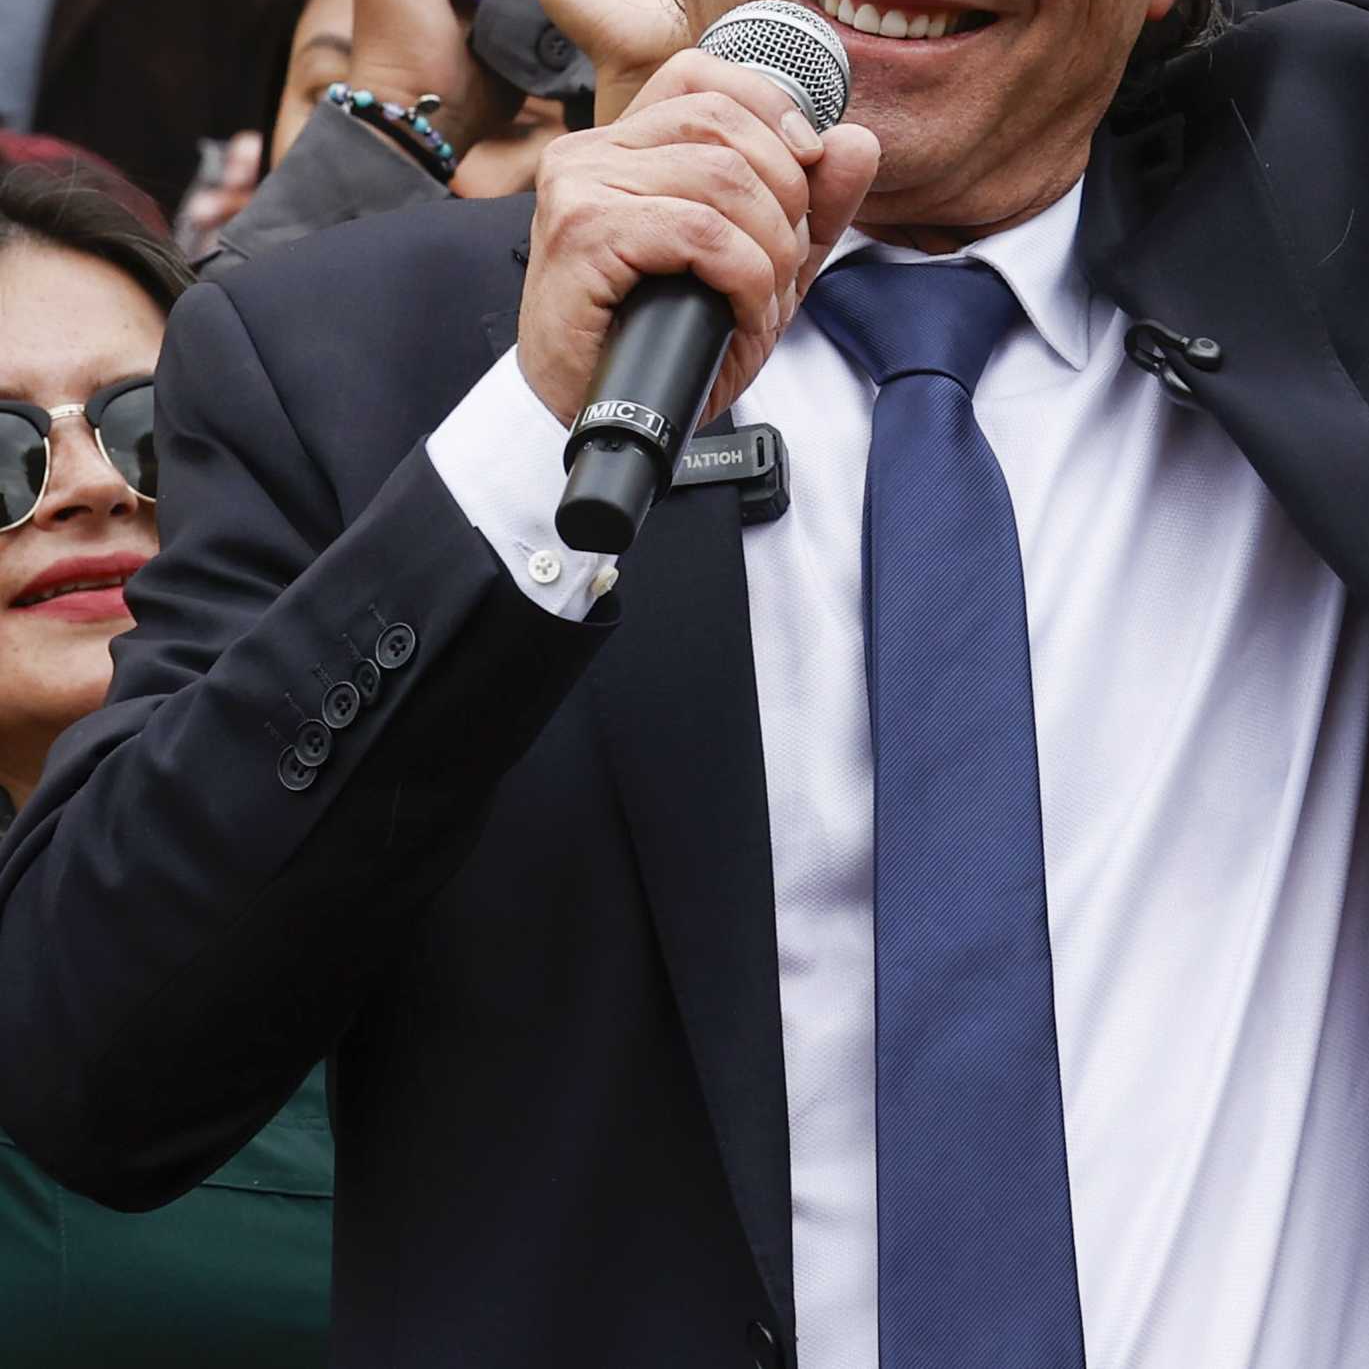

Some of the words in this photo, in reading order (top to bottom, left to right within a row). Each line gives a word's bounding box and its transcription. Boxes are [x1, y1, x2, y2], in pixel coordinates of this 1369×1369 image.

[587, 403, 636, 420] MIC
[645, 413, 656, 429] 1
[682, 450, 743, 469] HOLLYL
